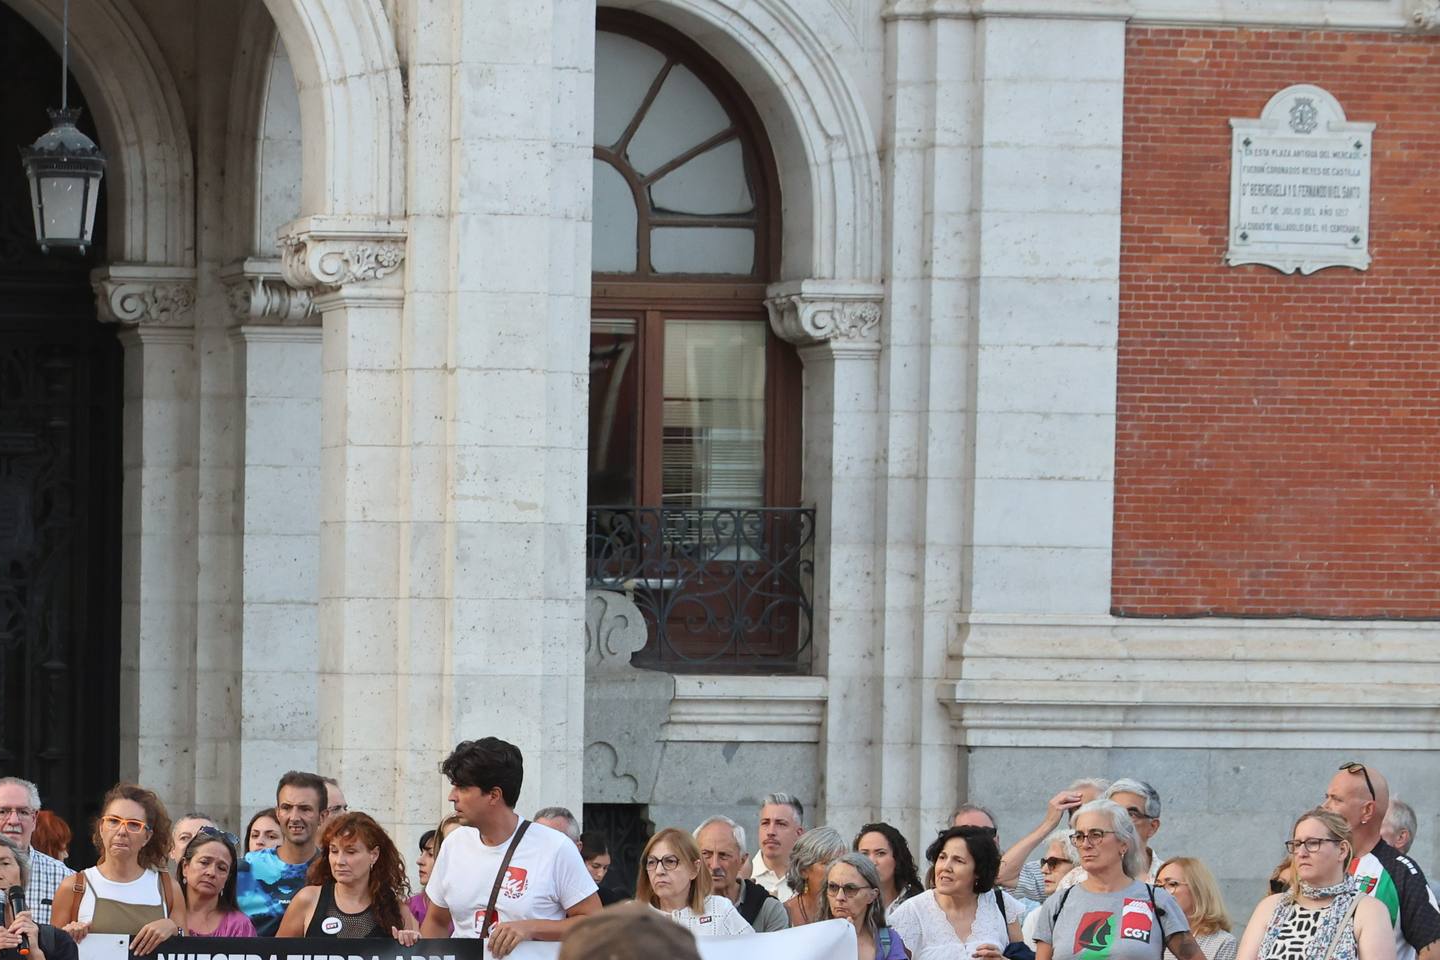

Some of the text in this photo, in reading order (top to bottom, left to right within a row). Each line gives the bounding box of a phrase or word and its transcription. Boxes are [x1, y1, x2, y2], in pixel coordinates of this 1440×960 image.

[1254, 148, 1269, 157] ESTA
[1271, 149, 1291, 157] PLAZA
[1293, 149, 1317, 158] ANTIGUA
[1319, 150, 1330, 159] DEL
[1302, 167, 1321, 176] REYES
[1332, 167, 1360, 177] CASTILLA
[1342, 185, 1360, 199] SANTO
[1270, 206, 1279, 215] DE
[1303, 207, 1316, 217] DEL
[1319, 204, 1333, 217] AÑO
[1123, 927, 1150, 941] CGT
